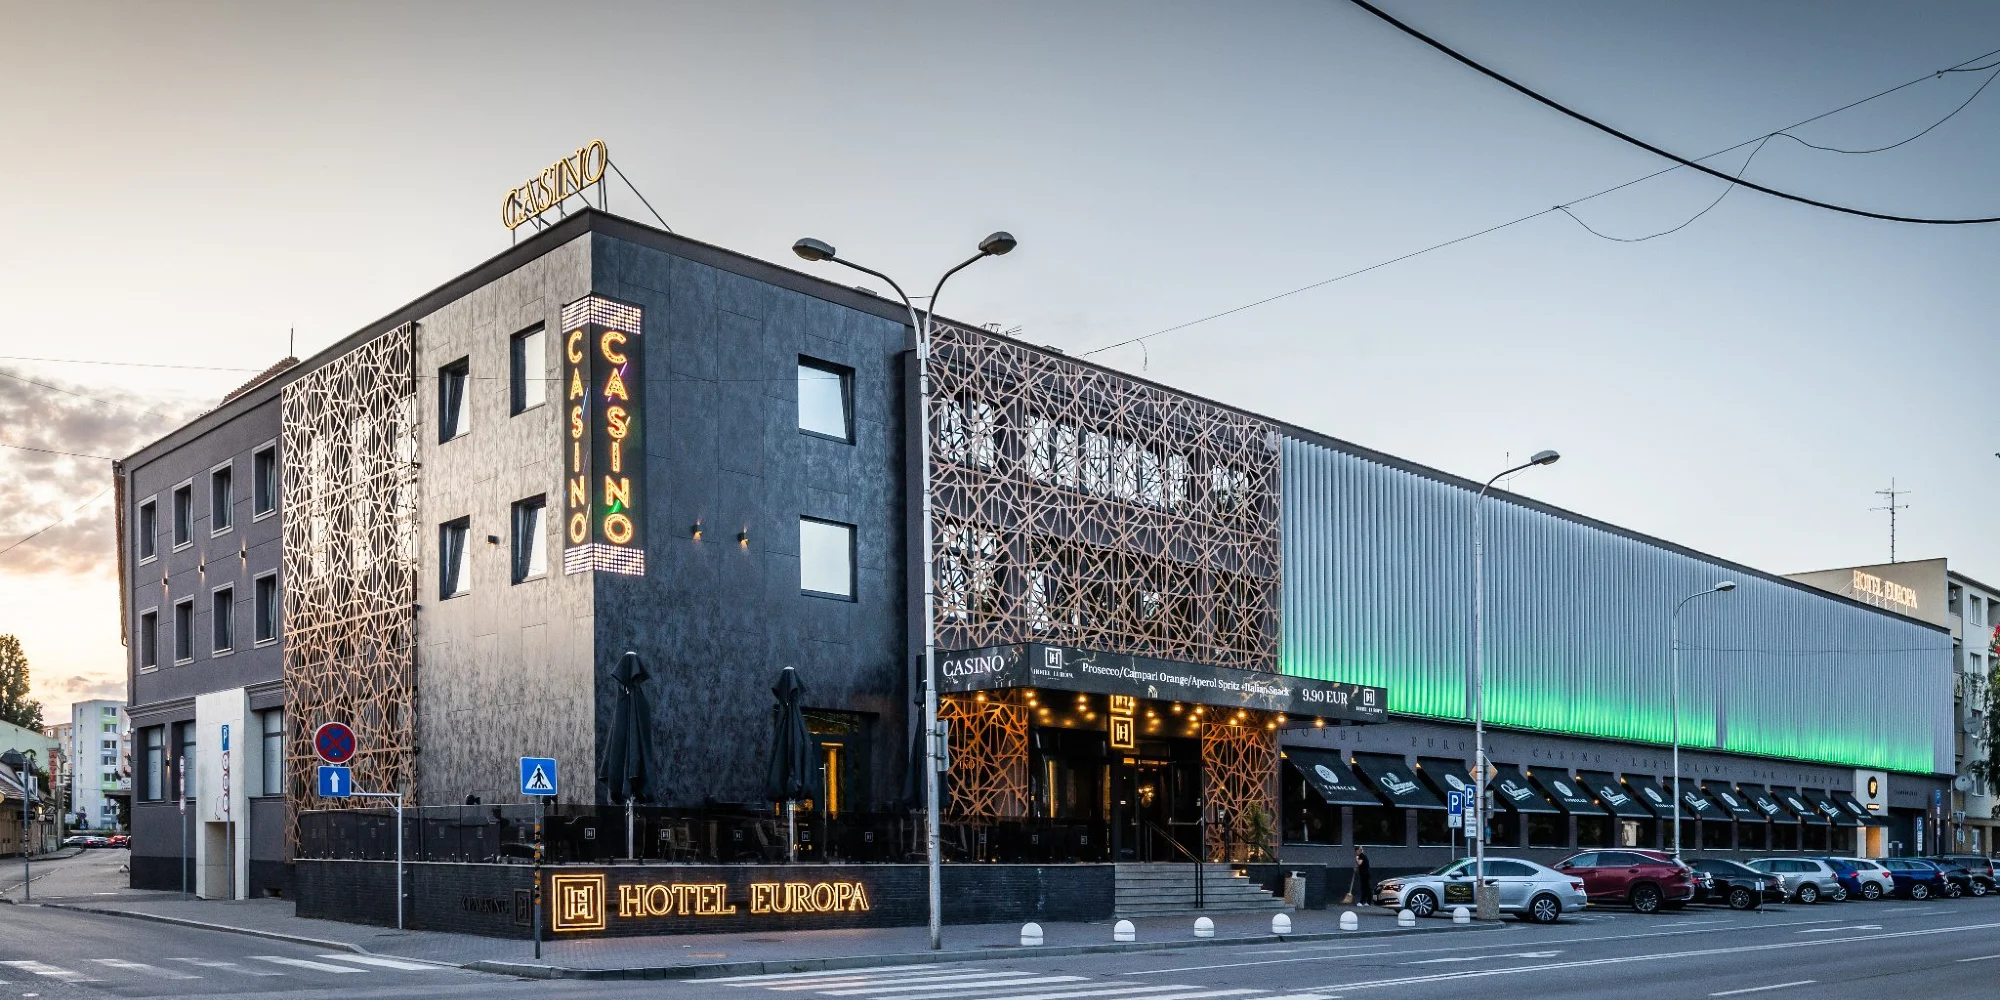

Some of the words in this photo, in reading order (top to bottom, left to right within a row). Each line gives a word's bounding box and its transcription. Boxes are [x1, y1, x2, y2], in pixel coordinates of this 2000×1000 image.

[502, 138, 607, 230] CASINO
[567, 329, 588, 545] CASINO
[600, 330, 633, 545] CASINO
[1853, 570, 1883, 598] HOTEL
[1884, 580, 1918, 609] EUROPA
[942, 655, 1005, 677] CASINO
[1082, 662, 1158, 681] Prosecco/Campari
[1159, 673, 1217, 688] Orange/Aperol
[1218, 679, 1240, 691] Spritz
[1302, 689, 1324, 702] 9.90
[1327, 691, 1348, 704] EUR
[1412, 736, 1495, 754] EUROA
[1533, 748, 1601, 764] CASINO
[1451, 794, 1459, 812] P
[618, 884, 736, 917] HOTEL
[751, 882, 869, 914] EUROPA
